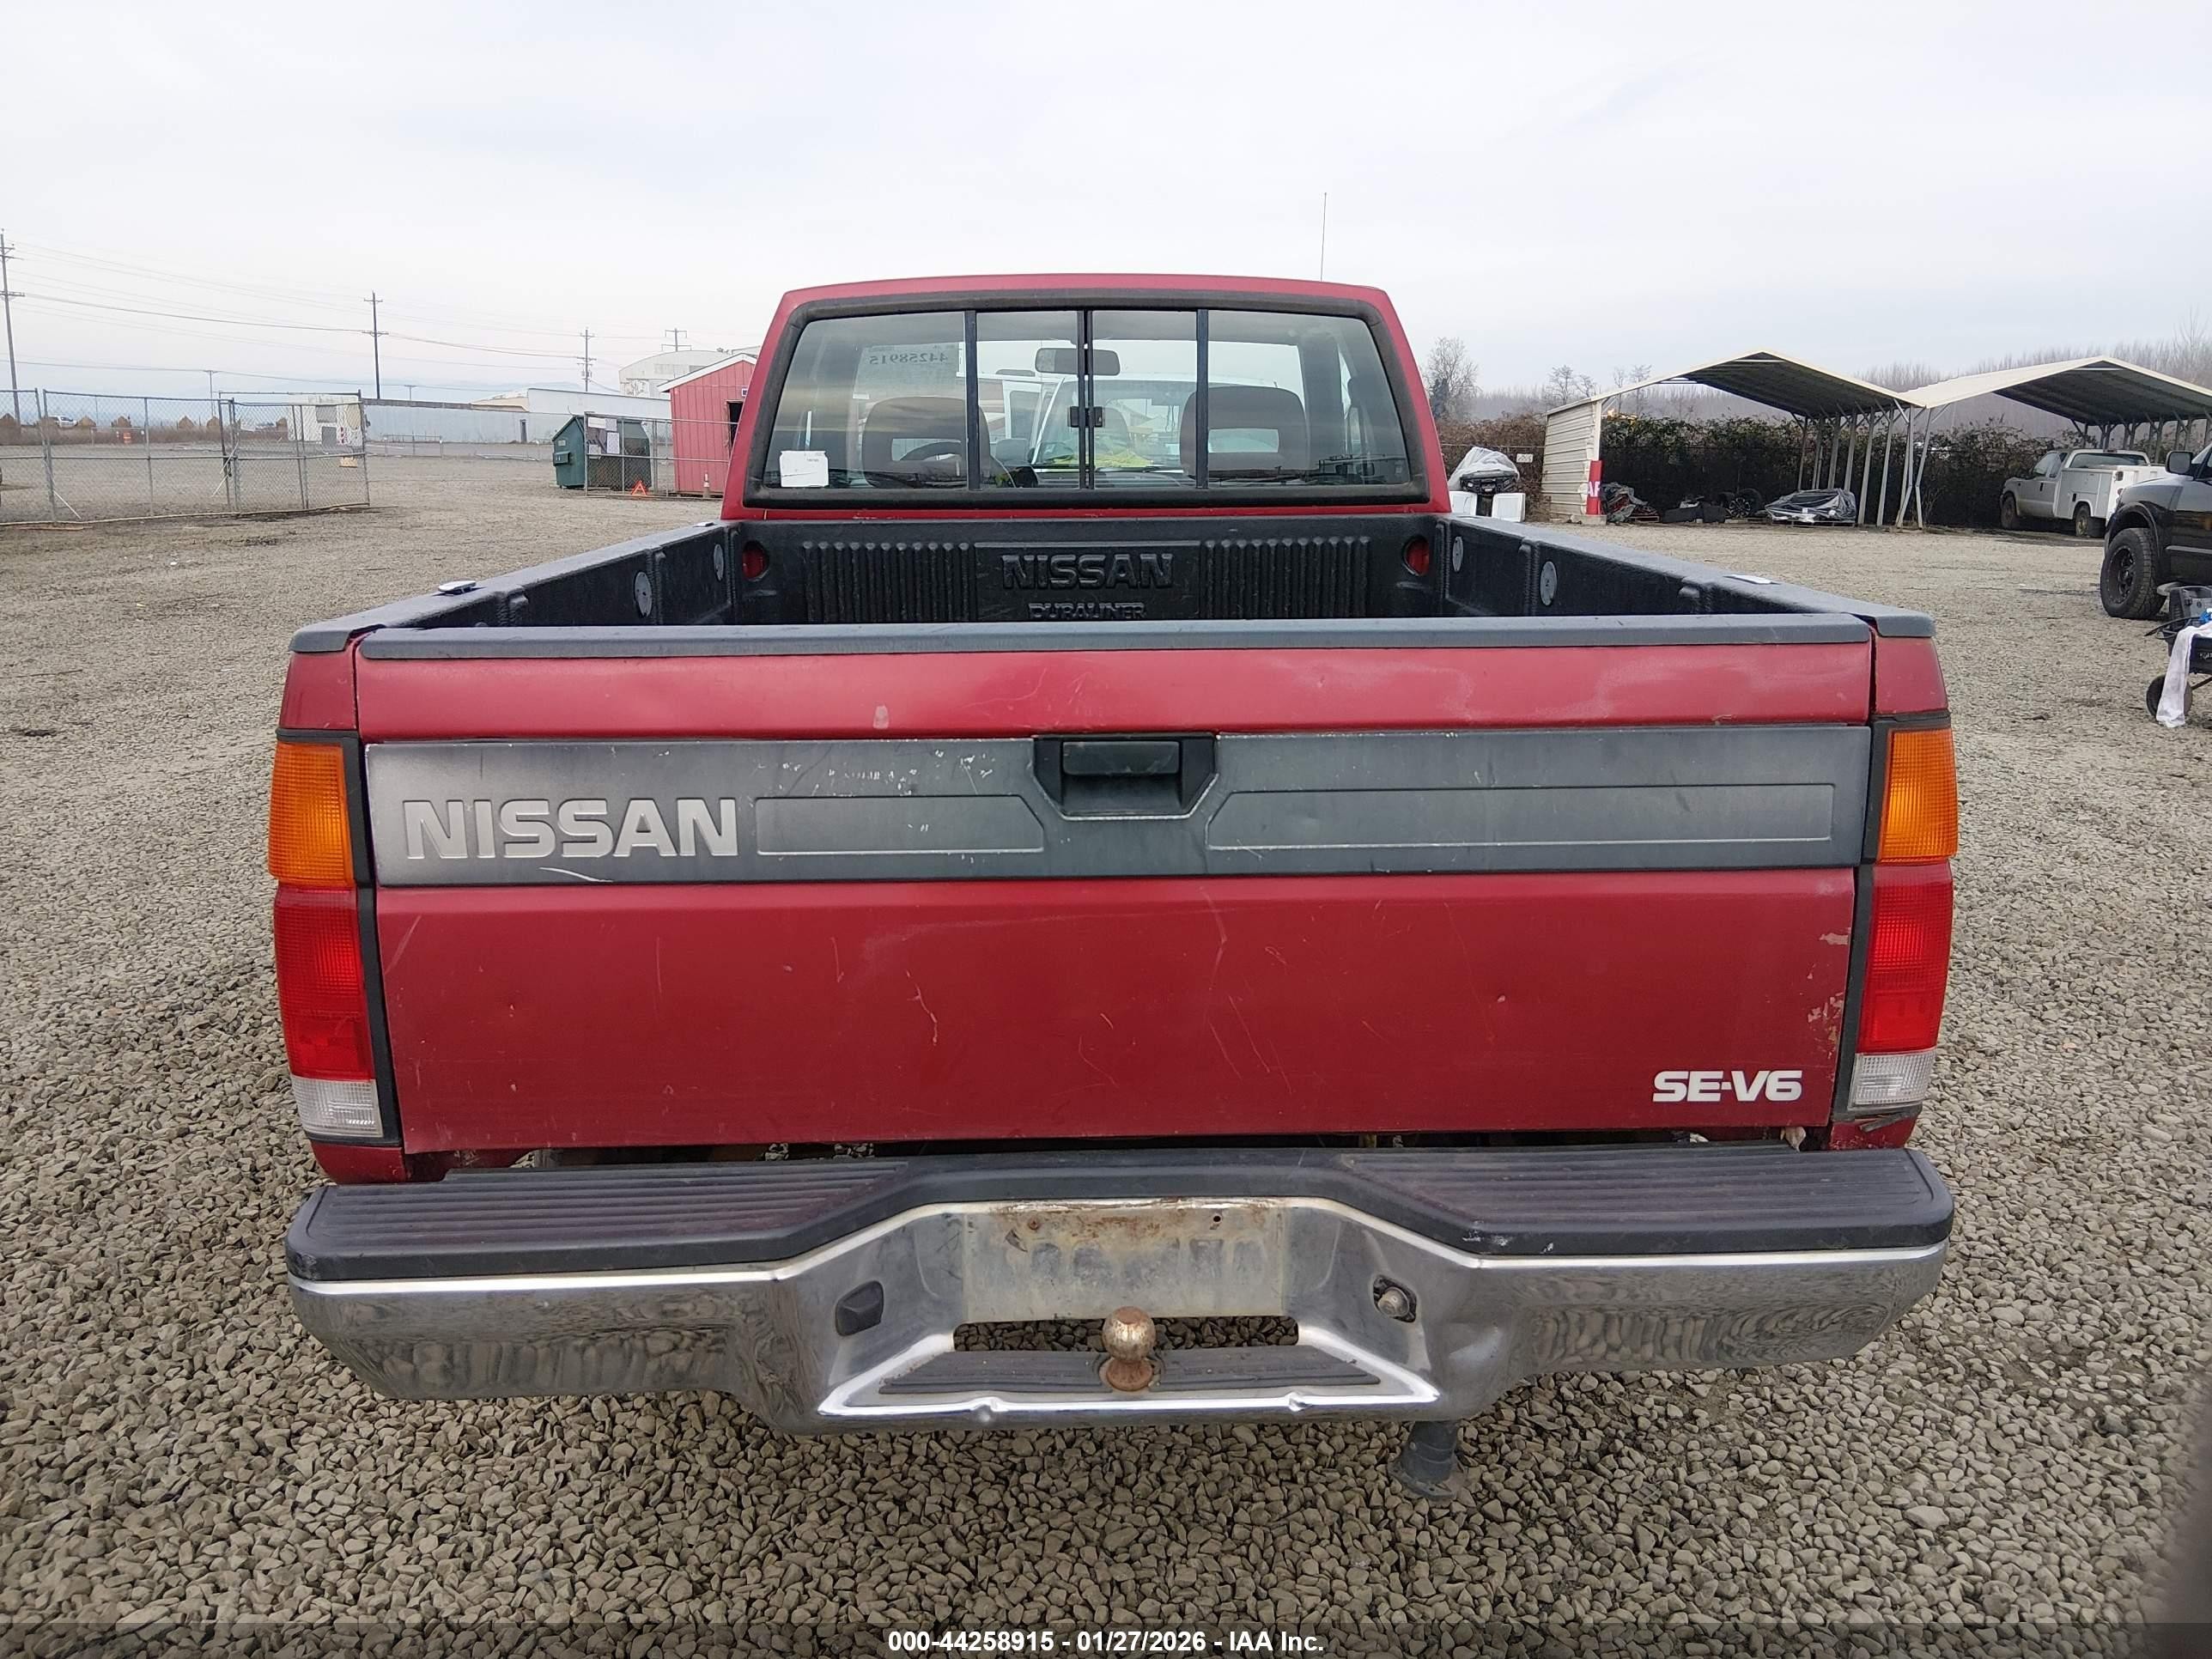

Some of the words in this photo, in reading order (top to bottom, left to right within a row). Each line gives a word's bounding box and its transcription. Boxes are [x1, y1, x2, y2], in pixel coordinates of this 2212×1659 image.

[1001, 554, 1174, 590] NISSAN
[1029, 603, 1146, 620] DURALINER
[403, 798, 738, 859] NISSAN
[1652, 1070, 1802, 1103] SE-V6
